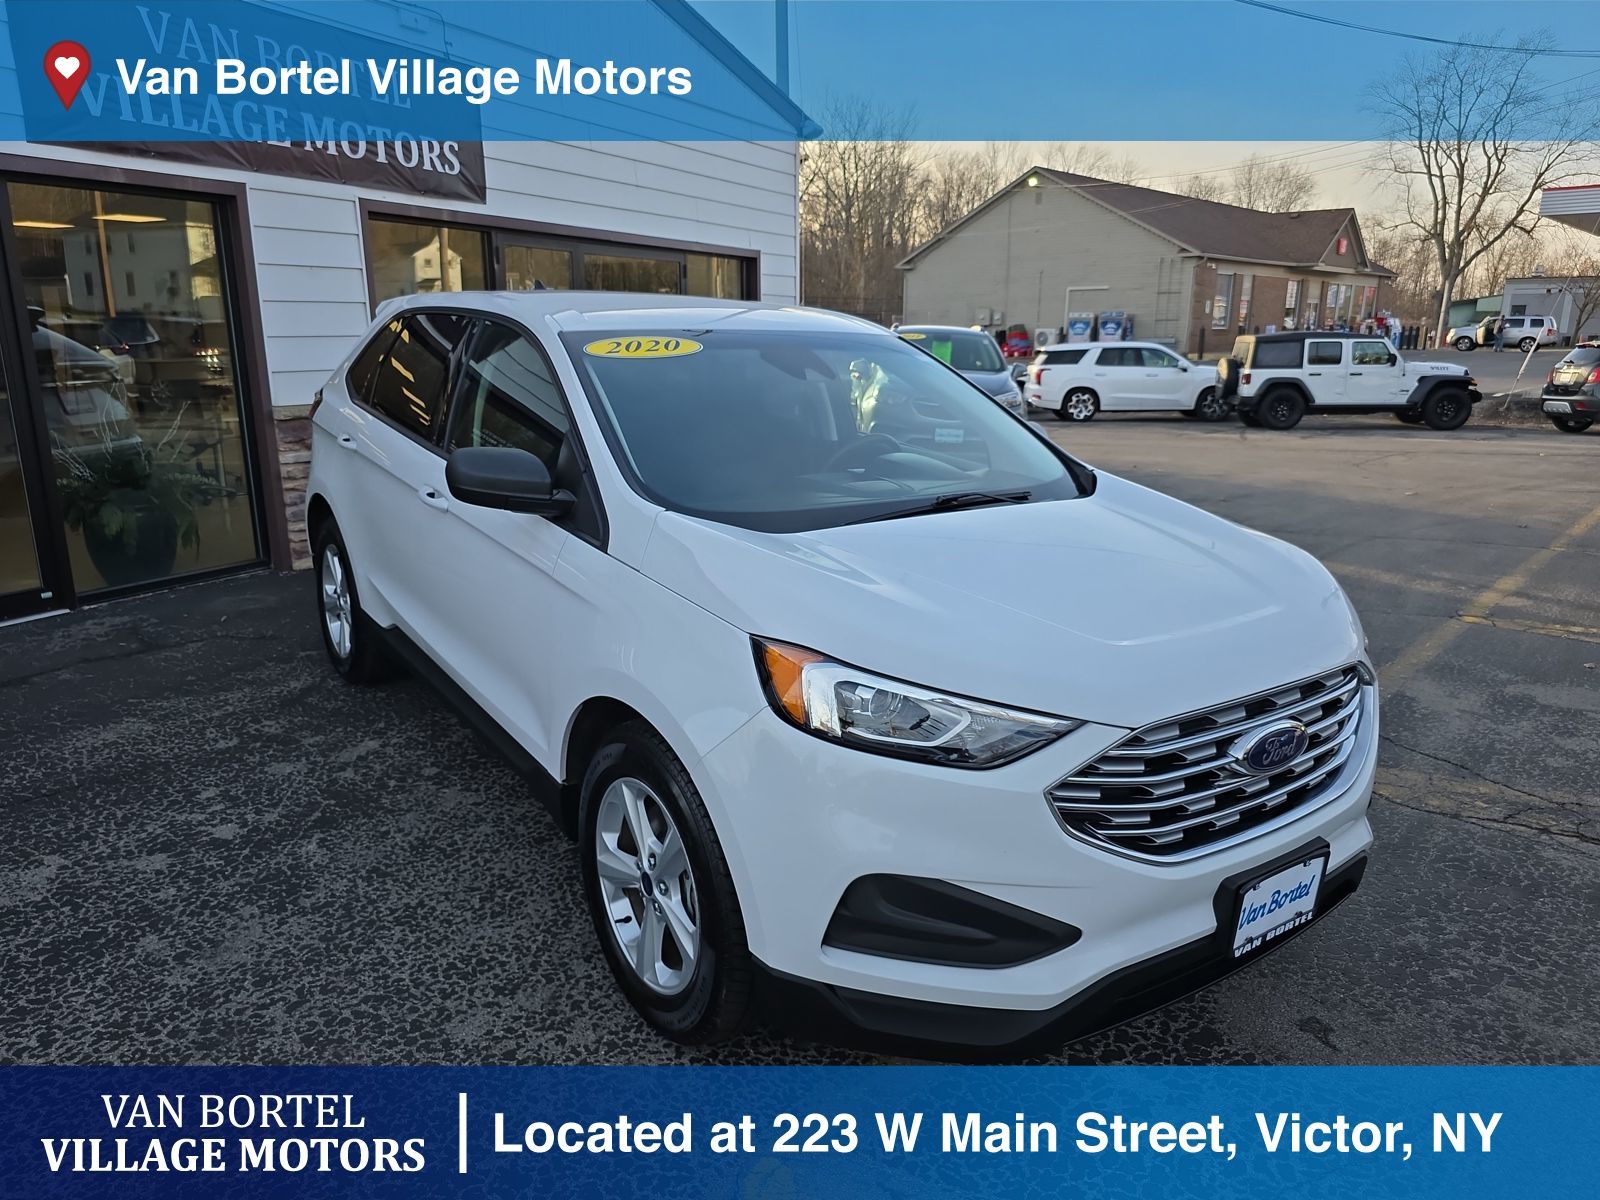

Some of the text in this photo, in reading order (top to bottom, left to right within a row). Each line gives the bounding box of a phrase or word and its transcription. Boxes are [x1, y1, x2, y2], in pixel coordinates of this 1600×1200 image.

[136, 5, 242, 68] VAN
[80, 72, 461, 176] VILLAGE MOTORS
[604, 339, 681, 354] 2020
[1262, 733, 1298, 766] Ford
[1239, 874, 1316, 930] Van Bortel
[1234, 937, 1262, 958] VAN
